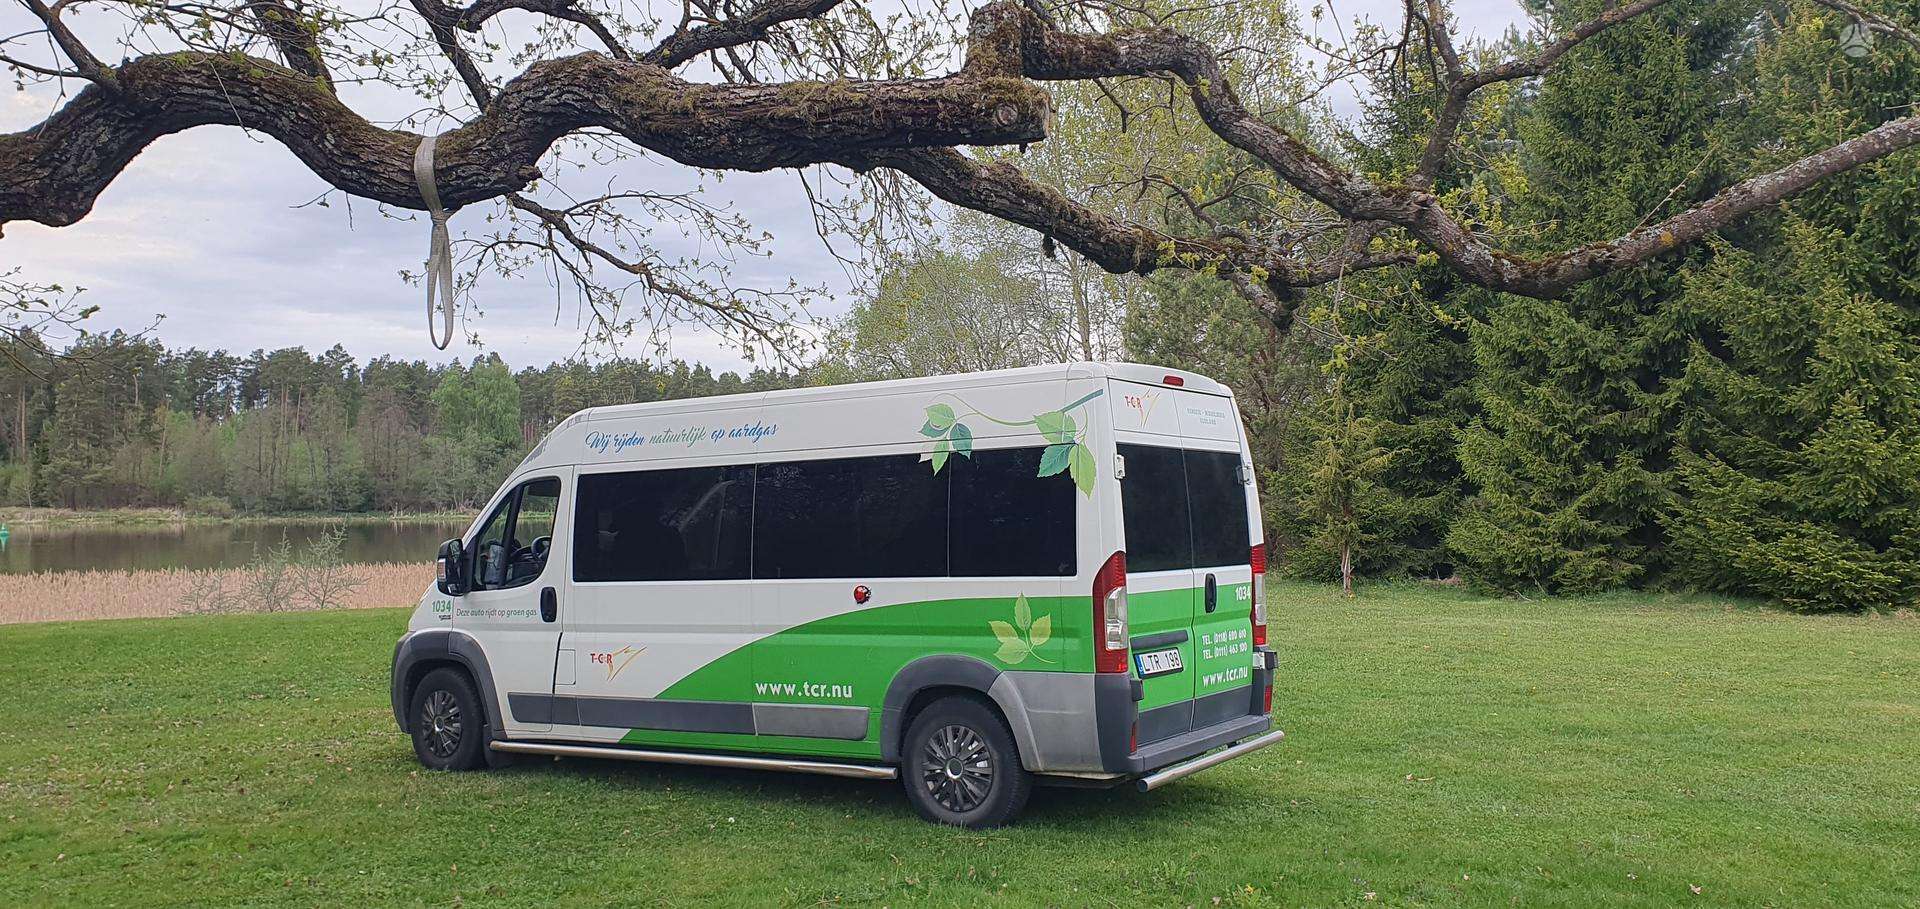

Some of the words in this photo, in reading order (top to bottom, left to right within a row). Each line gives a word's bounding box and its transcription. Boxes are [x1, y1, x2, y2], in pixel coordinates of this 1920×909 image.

[585, 431, 610, 453] Wij
[614, 431, 645, 453] rijden
[649, 426, 706, 448] natuurlijk
[711, 428, 725, 442] op
[728, 420, 778, 443] aardgas
[1235, 586, 1251, 600] 1034
[431, 601, 451, 612] 1034
[456, 608, 469, 616] Deze
[470, 608, 484, 616] auto
[498, 609, 505, 618] op
[526, 609, 537, 618] gas
[1142, 654, 1161, 671] LTR
[1165, 651, 1180, 668] 198
[1203, 666, 1248, 687] www.tcr.nu
[755, 681, 853, 698] www.tcr.nu
